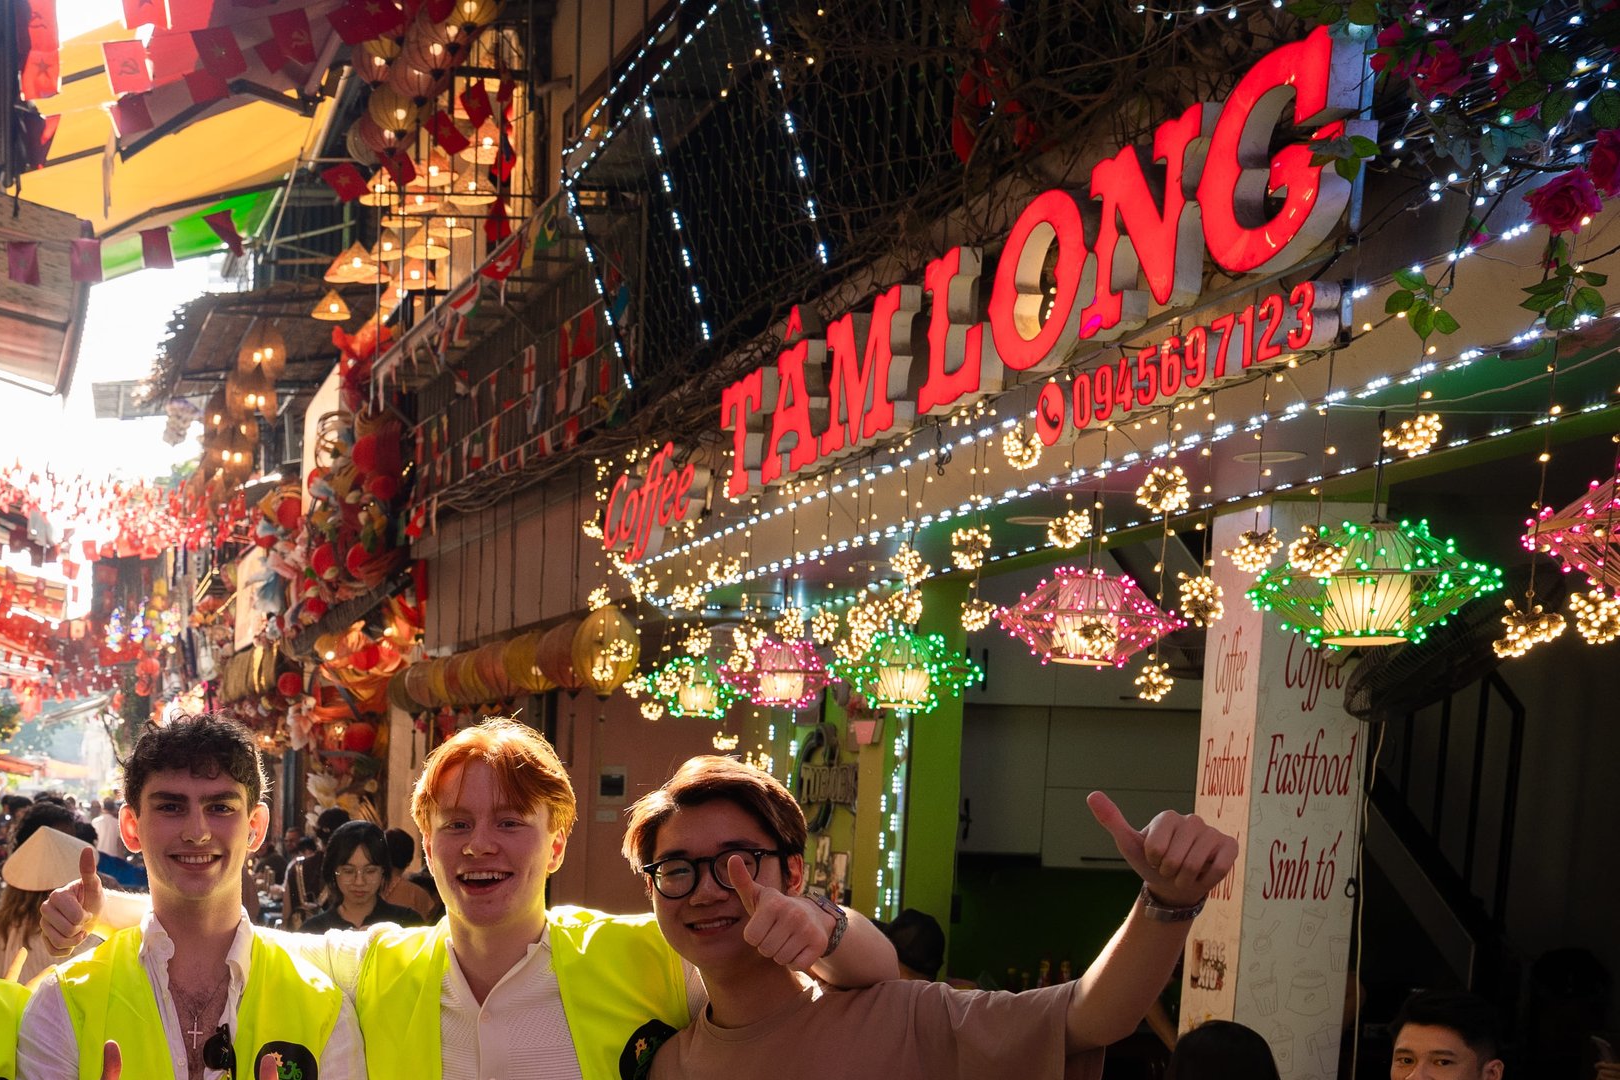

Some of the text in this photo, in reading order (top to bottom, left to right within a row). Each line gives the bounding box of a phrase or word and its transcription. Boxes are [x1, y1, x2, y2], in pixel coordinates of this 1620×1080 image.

[604, 24, 1346, 563] Coffee TÂM LONG
[1072, 281, 1315, 430] 0945697123
[1214, 625, 1248, 716] Coffee
[1200, 730, 1251, 819] Fastfood
[1261, 728, 1358, 818] Fastfood
[1262, 830, 1343, 901] Sinh tố
